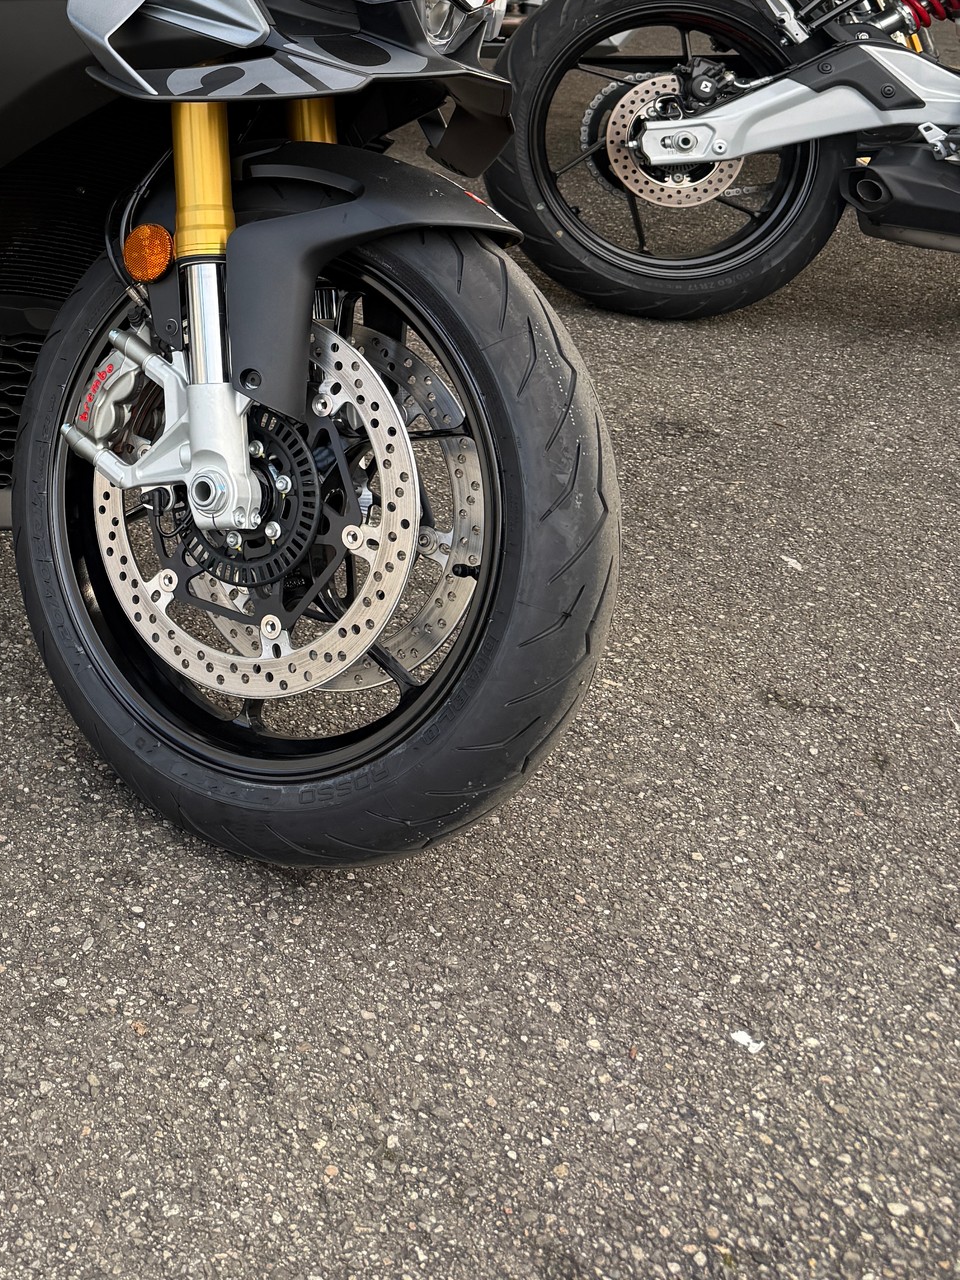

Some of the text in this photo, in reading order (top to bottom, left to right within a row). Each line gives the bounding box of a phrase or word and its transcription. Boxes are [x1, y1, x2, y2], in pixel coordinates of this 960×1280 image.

[79, 363, 114, 422] brembo
[422, 634, 500, 746] DIABLO
[298, 762, 391, 805] ROSSO
